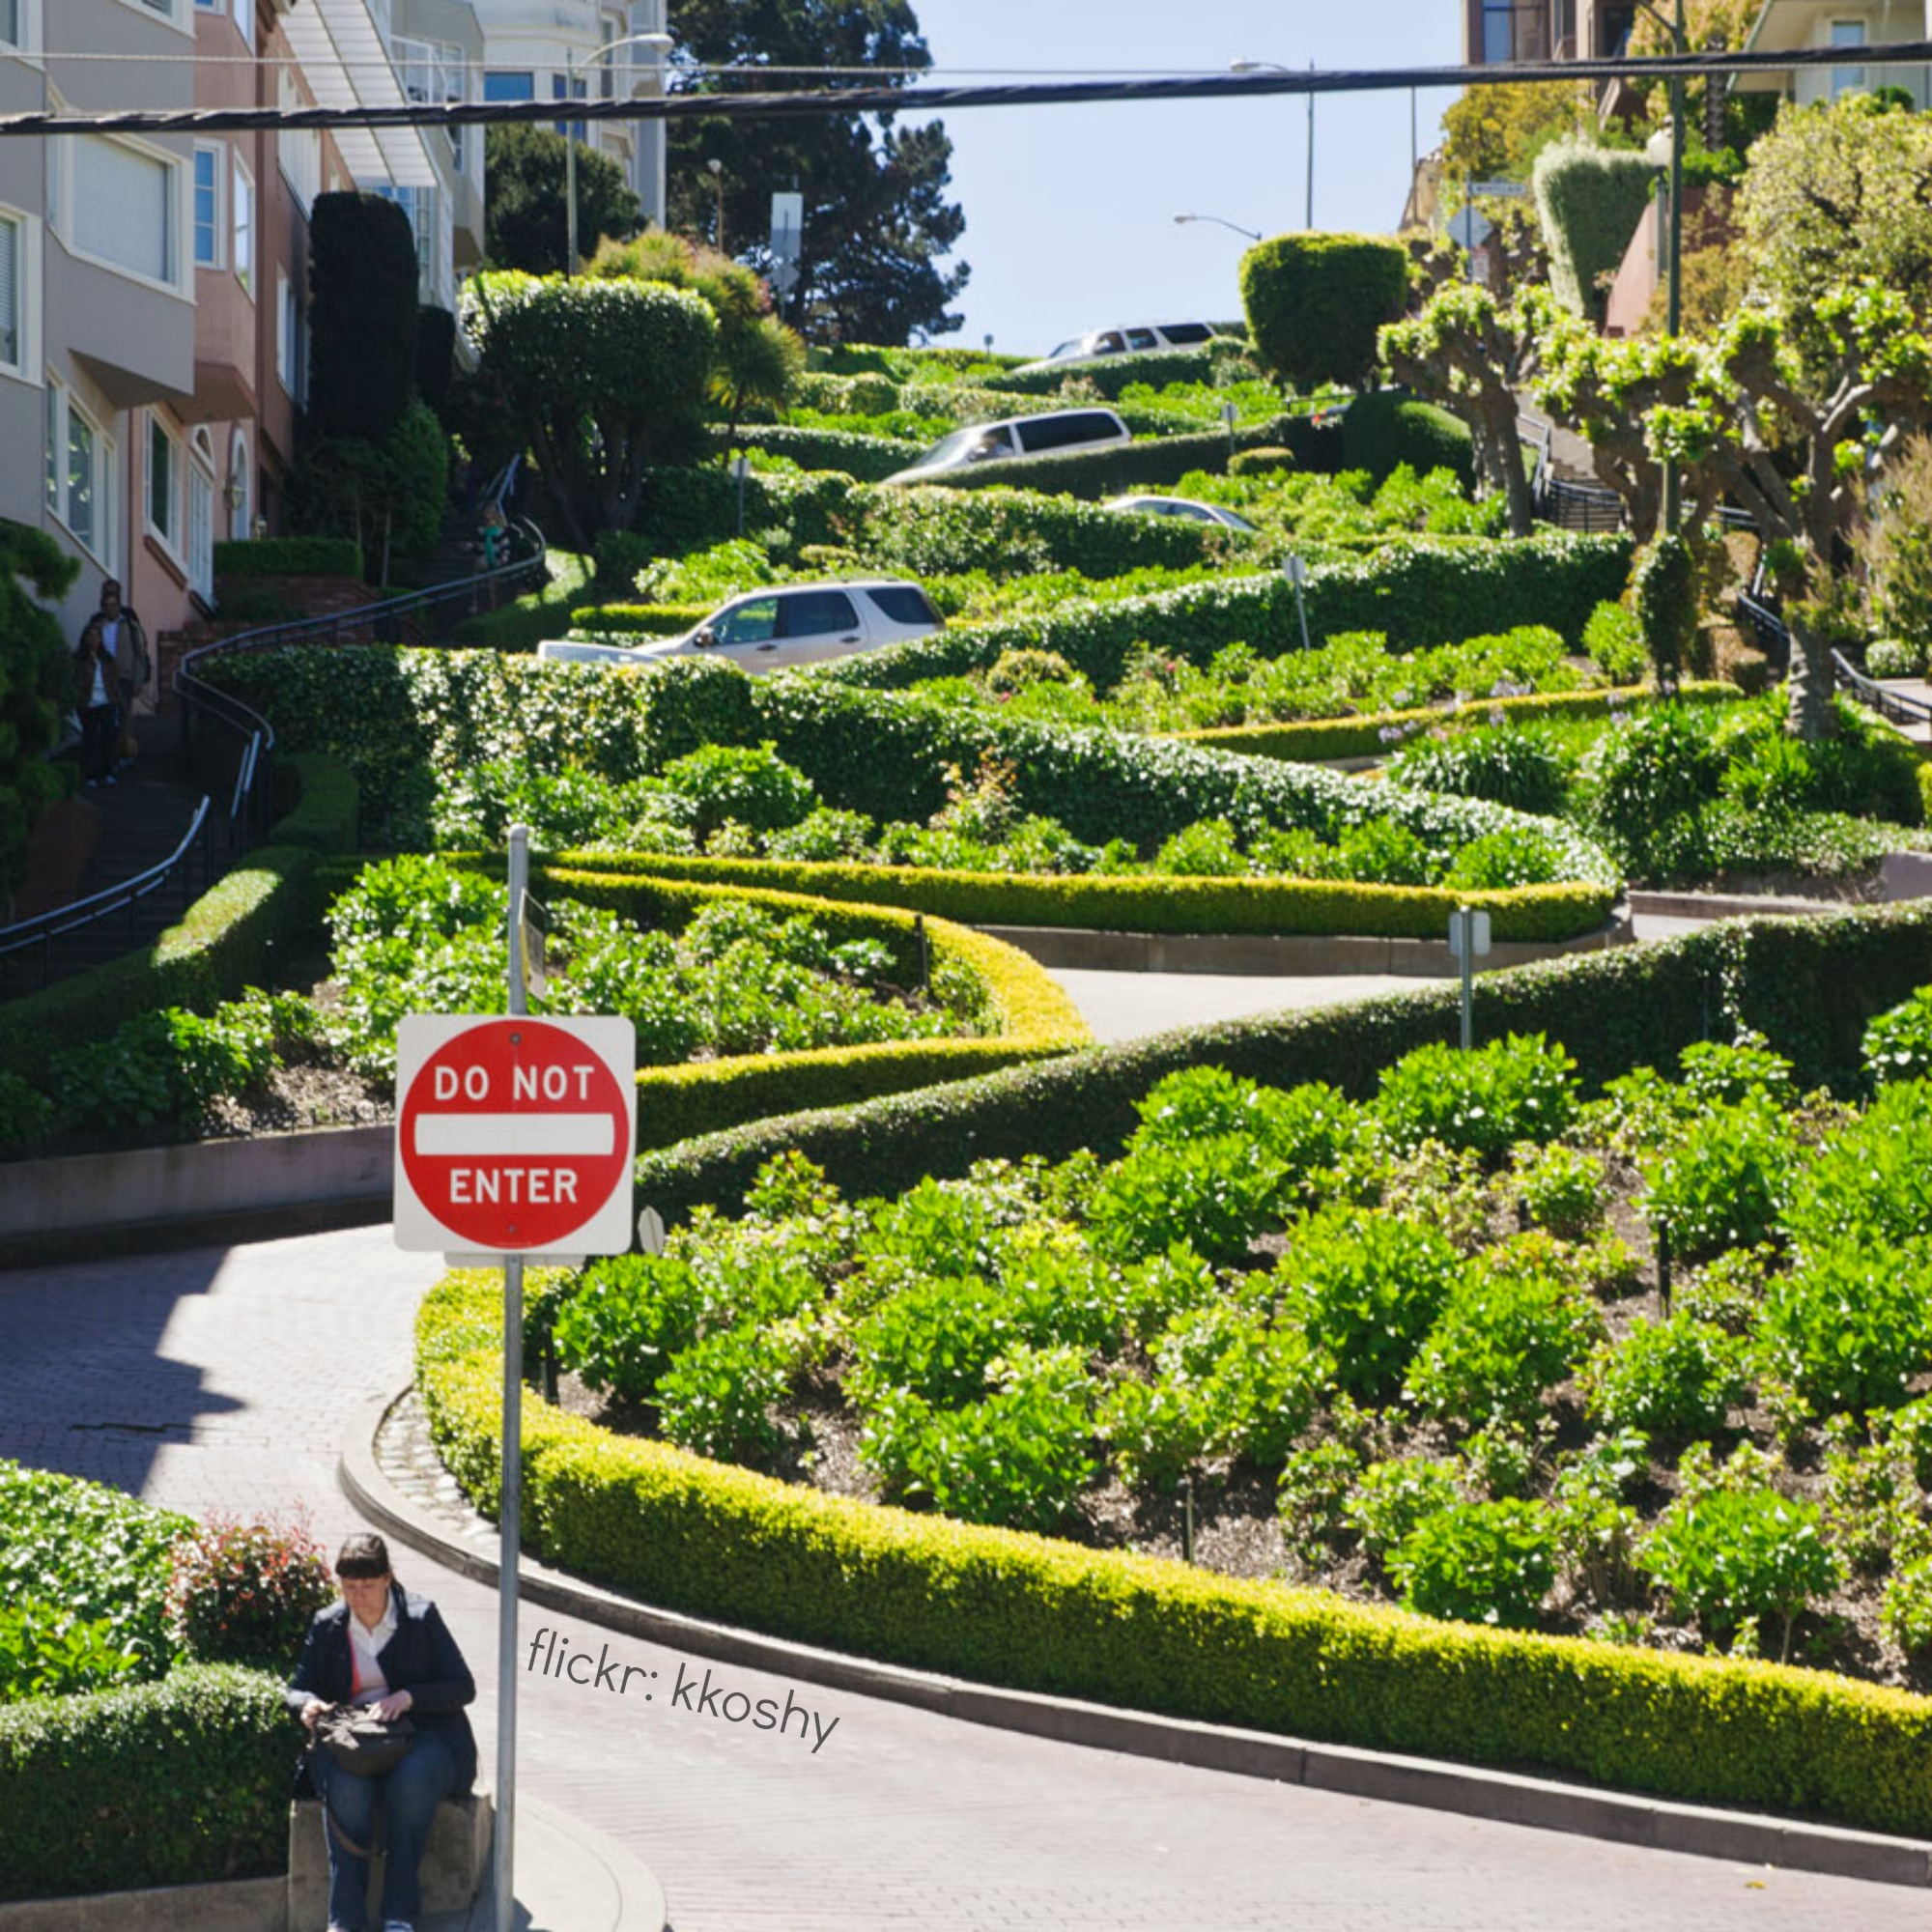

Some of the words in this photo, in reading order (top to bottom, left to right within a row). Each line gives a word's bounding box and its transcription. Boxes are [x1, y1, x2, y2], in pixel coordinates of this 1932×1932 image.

[435, 1065, 490, 1101] DO
[512, 1065, 595, 1101] NOT
[449, 1168, 579, 1205] ENTER
